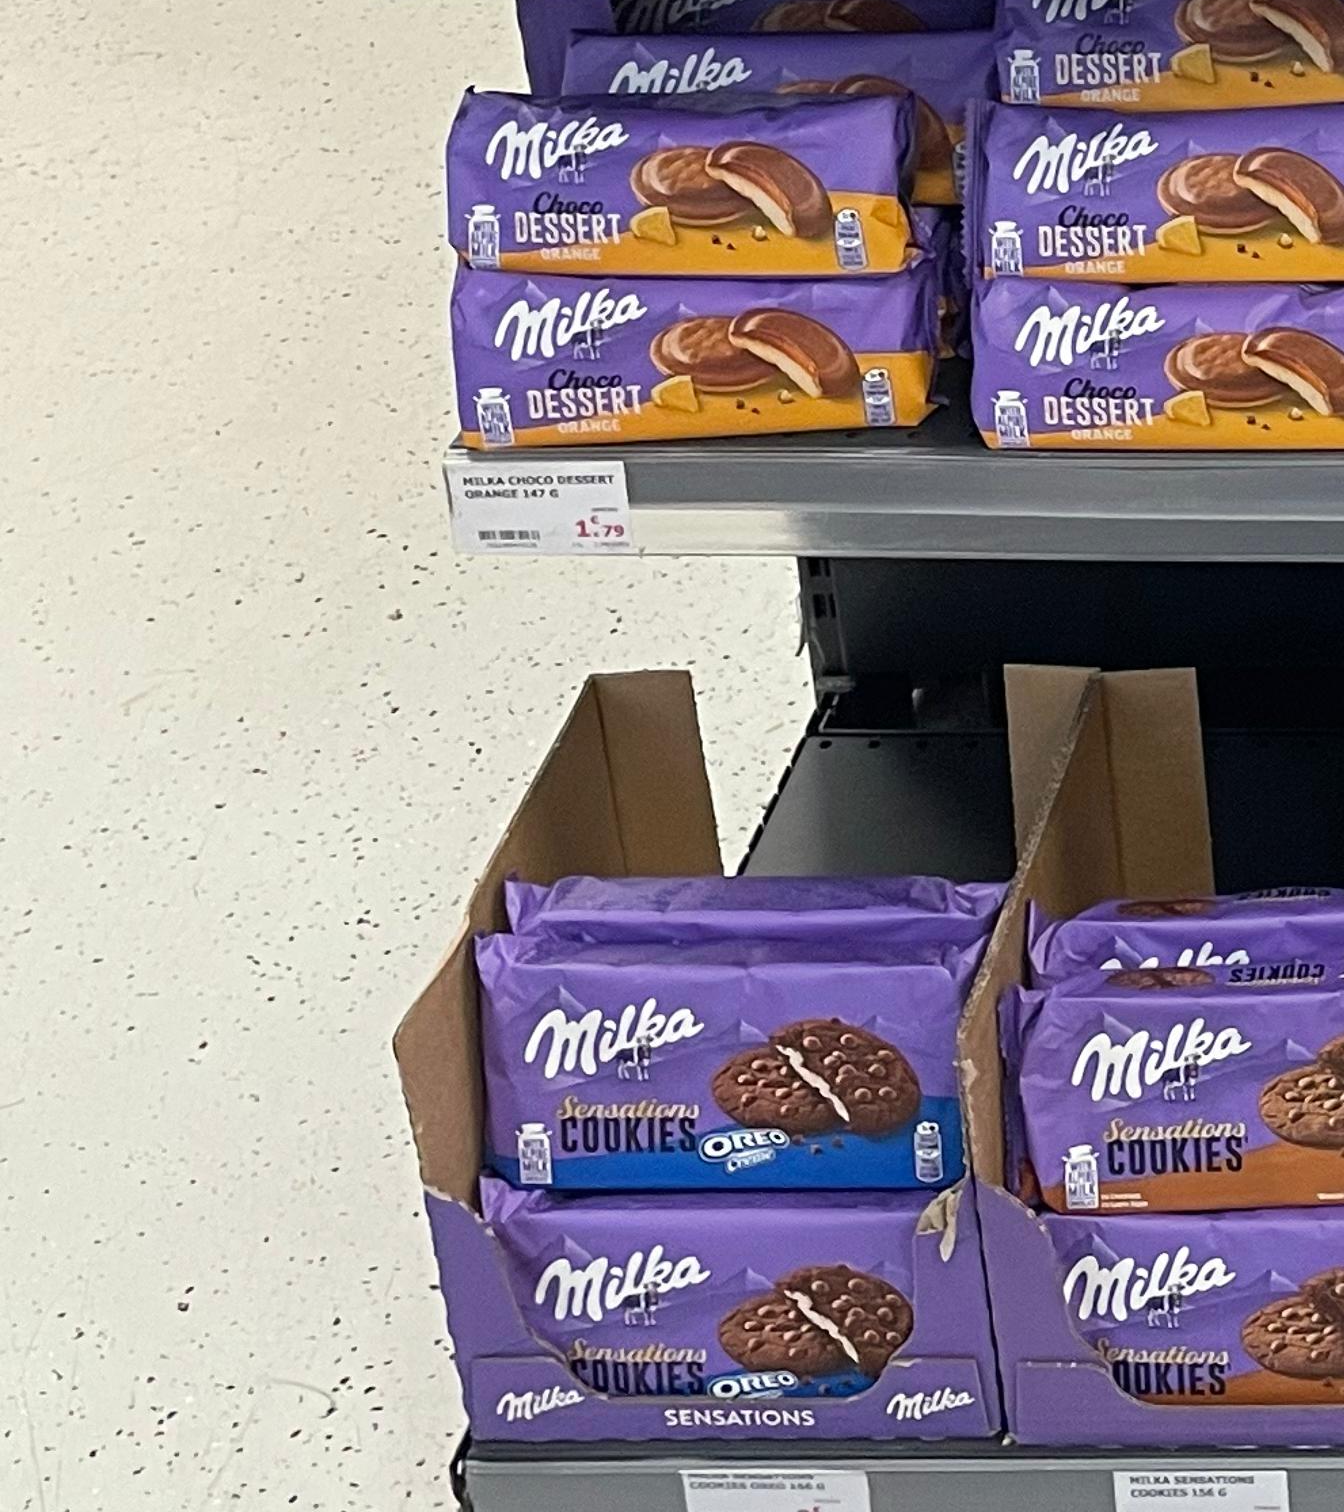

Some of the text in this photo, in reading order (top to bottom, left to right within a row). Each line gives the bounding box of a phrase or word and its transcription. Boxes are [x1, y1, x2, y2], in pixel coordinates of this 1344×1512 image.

[485, 115, 630, 182] Milka
[1012, 122, 1159, 195] Milka
[532, 190, 604, 215] Choco
[1058, 204, 1129, 227] Choco
[514, 211, 621, 245] DESSERT
[1038, 224, 1147, 258] DESSERT
[540, 247, 602, 262] ORANGE
[1065, 259, 1126, 275] ORANGE
[494, 287, 647, 362] Milka
[1014, 296, 1166, 368] Milka
[526, 384, 642, 420] DESSERT
[1043, 395, 1155, 428] DESSERT
[463, 475, 614, 487] MILKA CHOCO DESSERT
[464, 490, 518, 499] ORANGE
[523, 997, 705, 1079] Milka
[1071, 1017, 1252, 1102] Milka
[555, 1095, 700, 1121] Sensations
[560, 1117, 696, 1154] COOKIES
[701, 1130, 786, 1160] OREO
[1103, 1118, 1246, 1143] Sensations
[1107, 1138, 1242, 1175] COOKIES
[535, 1245, 711, 1324] Milka
[1062, 1246, 1237, 1322] Milka
[497, 1386, 586, 1421] Milka
[663, 1407, 815, 1427] SENSATIONS
[1129, 1475, 1171, 1488] MILKA
